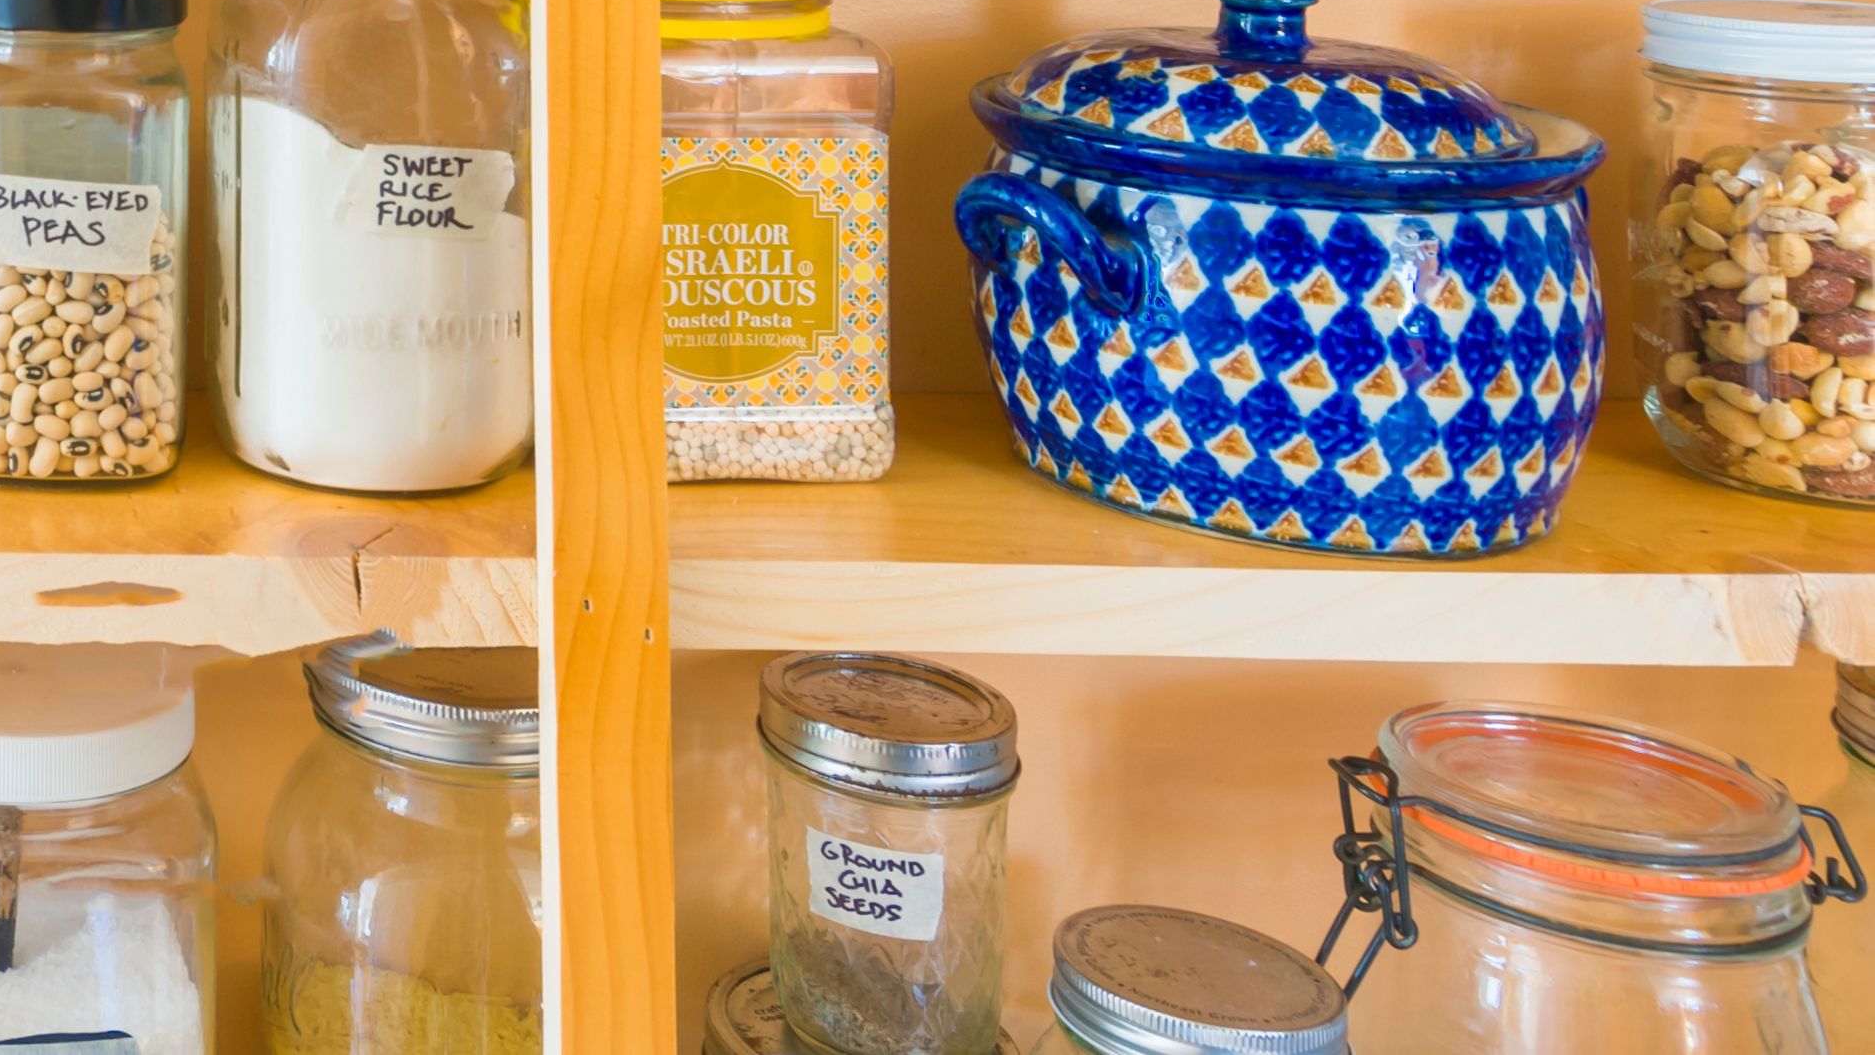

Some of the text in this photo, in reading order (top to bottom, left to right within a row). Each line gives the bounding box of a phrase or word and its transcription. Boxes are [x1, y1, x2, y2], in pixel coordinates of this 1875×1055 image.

[384, 154, 473, 177] SWEET
[380, 180, 453, 201] RICE
[376, 201, 475, 230] FLOUR
[23, 216, 105, 246] PEAS
[662, 223, 789, 245] TRI-COLOR
[665, 248, 795, 276] SRAELI
[663, 278, 817, 306] OUSCOUS
[417, 311, 521, 347] MOUTH
[663, 310, 793, 328] oasted Pasta
[821, 841, 925, 877] GROUND
[838, 869, 903, 898] CHIA
[825, 886, 902, 922] SEEDS
